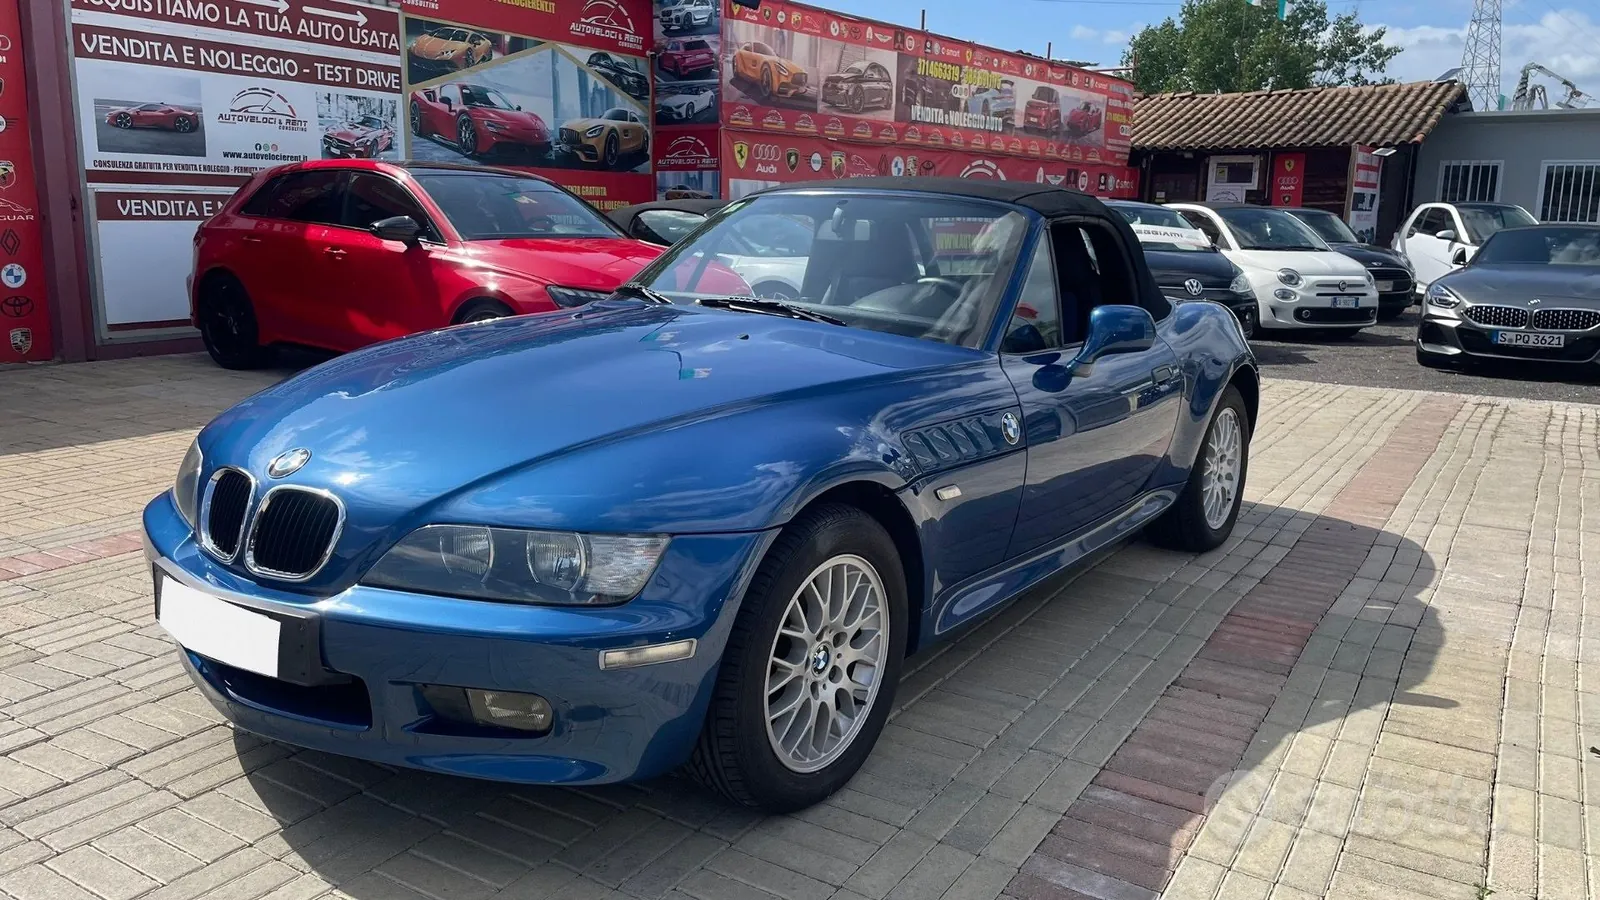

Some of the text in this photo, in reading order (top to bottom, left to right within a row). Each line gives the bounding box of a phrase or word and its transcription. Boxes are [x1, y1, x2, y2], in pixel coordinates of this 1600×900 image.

[225, 7, 250, 28] LA
[254, 11, 292, 34] TUA
[297, 18, 345, 42] AUTO
[349, 26, 399, 50] USATA
[570, 22, 617, 40] AUTOVELOCI
[80, 32, 178, 63] VENDITA
[182, 45, 195, 65] E
[200, 47, 299, 78] NOLEGGIO
[314, 62, 352, 83] TEST
[356, 68, 400, 90] DRIVE
[218, 113, 277, 125] AUTOVELOCI
[911, 104, 944, 124] VENDITA
[949, 110, 985, 130] NOLEGGIO
[985, 115, 1003, 132] AUTO
[222, 151, 308, 162] www.autovelocierent.it
[93, 159, 133, 169] CONSULENZA
[134, 161, 162, 170] GRATUITA
[162, 162, 174, 171] PER
[174, 163, 198, 172] VENDITA
[203, 165, 230, 173] NOLEGGIO
[755, 162, 777, 174] Audi
[116, 199, 199, 217] VENDITA
[203, 200, 213, 217] E
[1135, 228, 1184, 239] EGGIAMI
[1499, 332, 1563, 346] S PQ 3621
